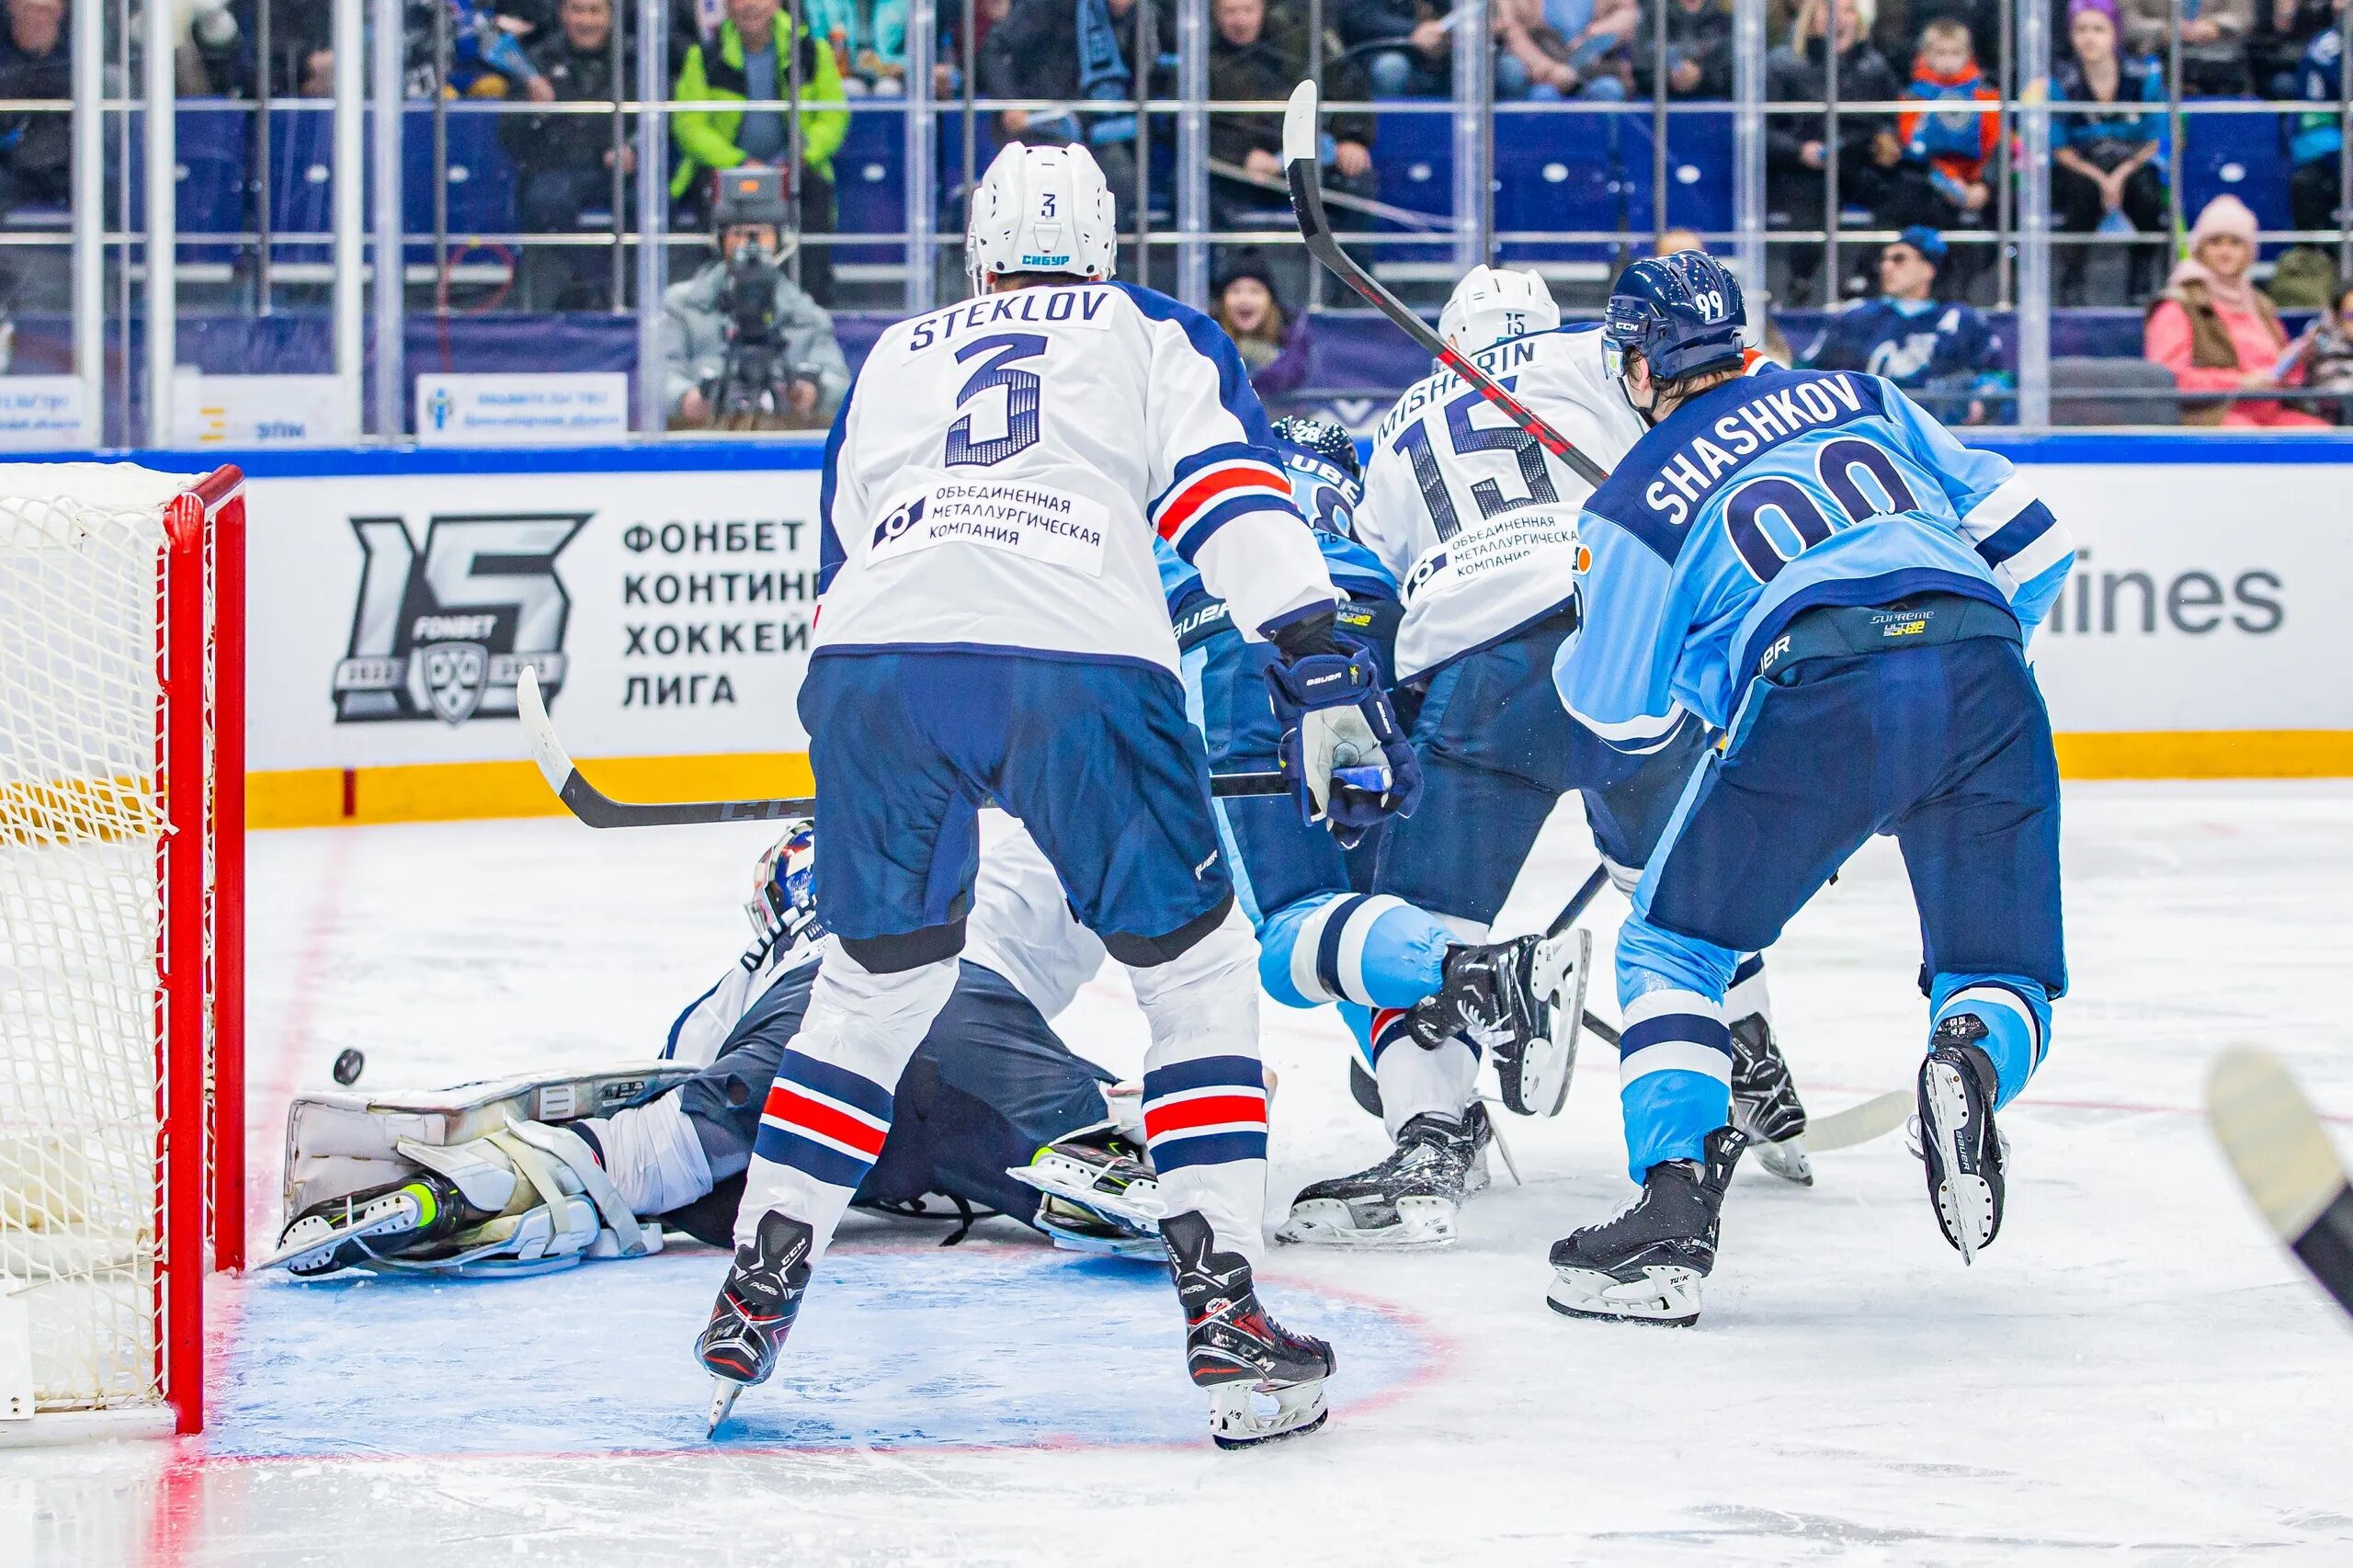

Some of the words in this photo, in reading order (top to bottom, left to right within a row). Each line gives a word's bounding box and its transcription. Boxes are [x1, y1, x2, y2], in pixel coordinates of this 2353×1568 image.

[1040, 193, 1056, 218] 3
[1021, 255, 1070, 266] СИБУР
[910, 291, 1108, 351] STEKLOV
[1696, 290, 1724, 322] 99
[1506, 312, 1526, 335] 15
[1615, 322, 1639, 332] CCM
[945, 333, 1049, 468] 3
[1392, 375, 1560, 544] 15
[1644, 373, 1863, 526] SHASHKOV
[1283, 453, 1361, 506] UBE
[936, 485, 1071, 515] ОБЪЕДИНЕННАЯ
[624, 523, 805, 552] ФОНБЕТ
[929, 522, 1019, 546] КОМПАНИЯ
[932, 503, 1101, 547] МЕТАЛЛУРГИЧЕСКАЯ
[1452, 516, 1555, 551] ОБЪЕДИНЕННАЯ
[336, 512, 595, 722] 15
[625, 612, 808, 656] ХОККЕЙ
[623, 676, 736, 706] ЛИГА
[1306, 672, 1342, 687] BAUER
[1954, 1131, 1972, 1171] BAUER
[781, 1237, 807, 1267] CCM
